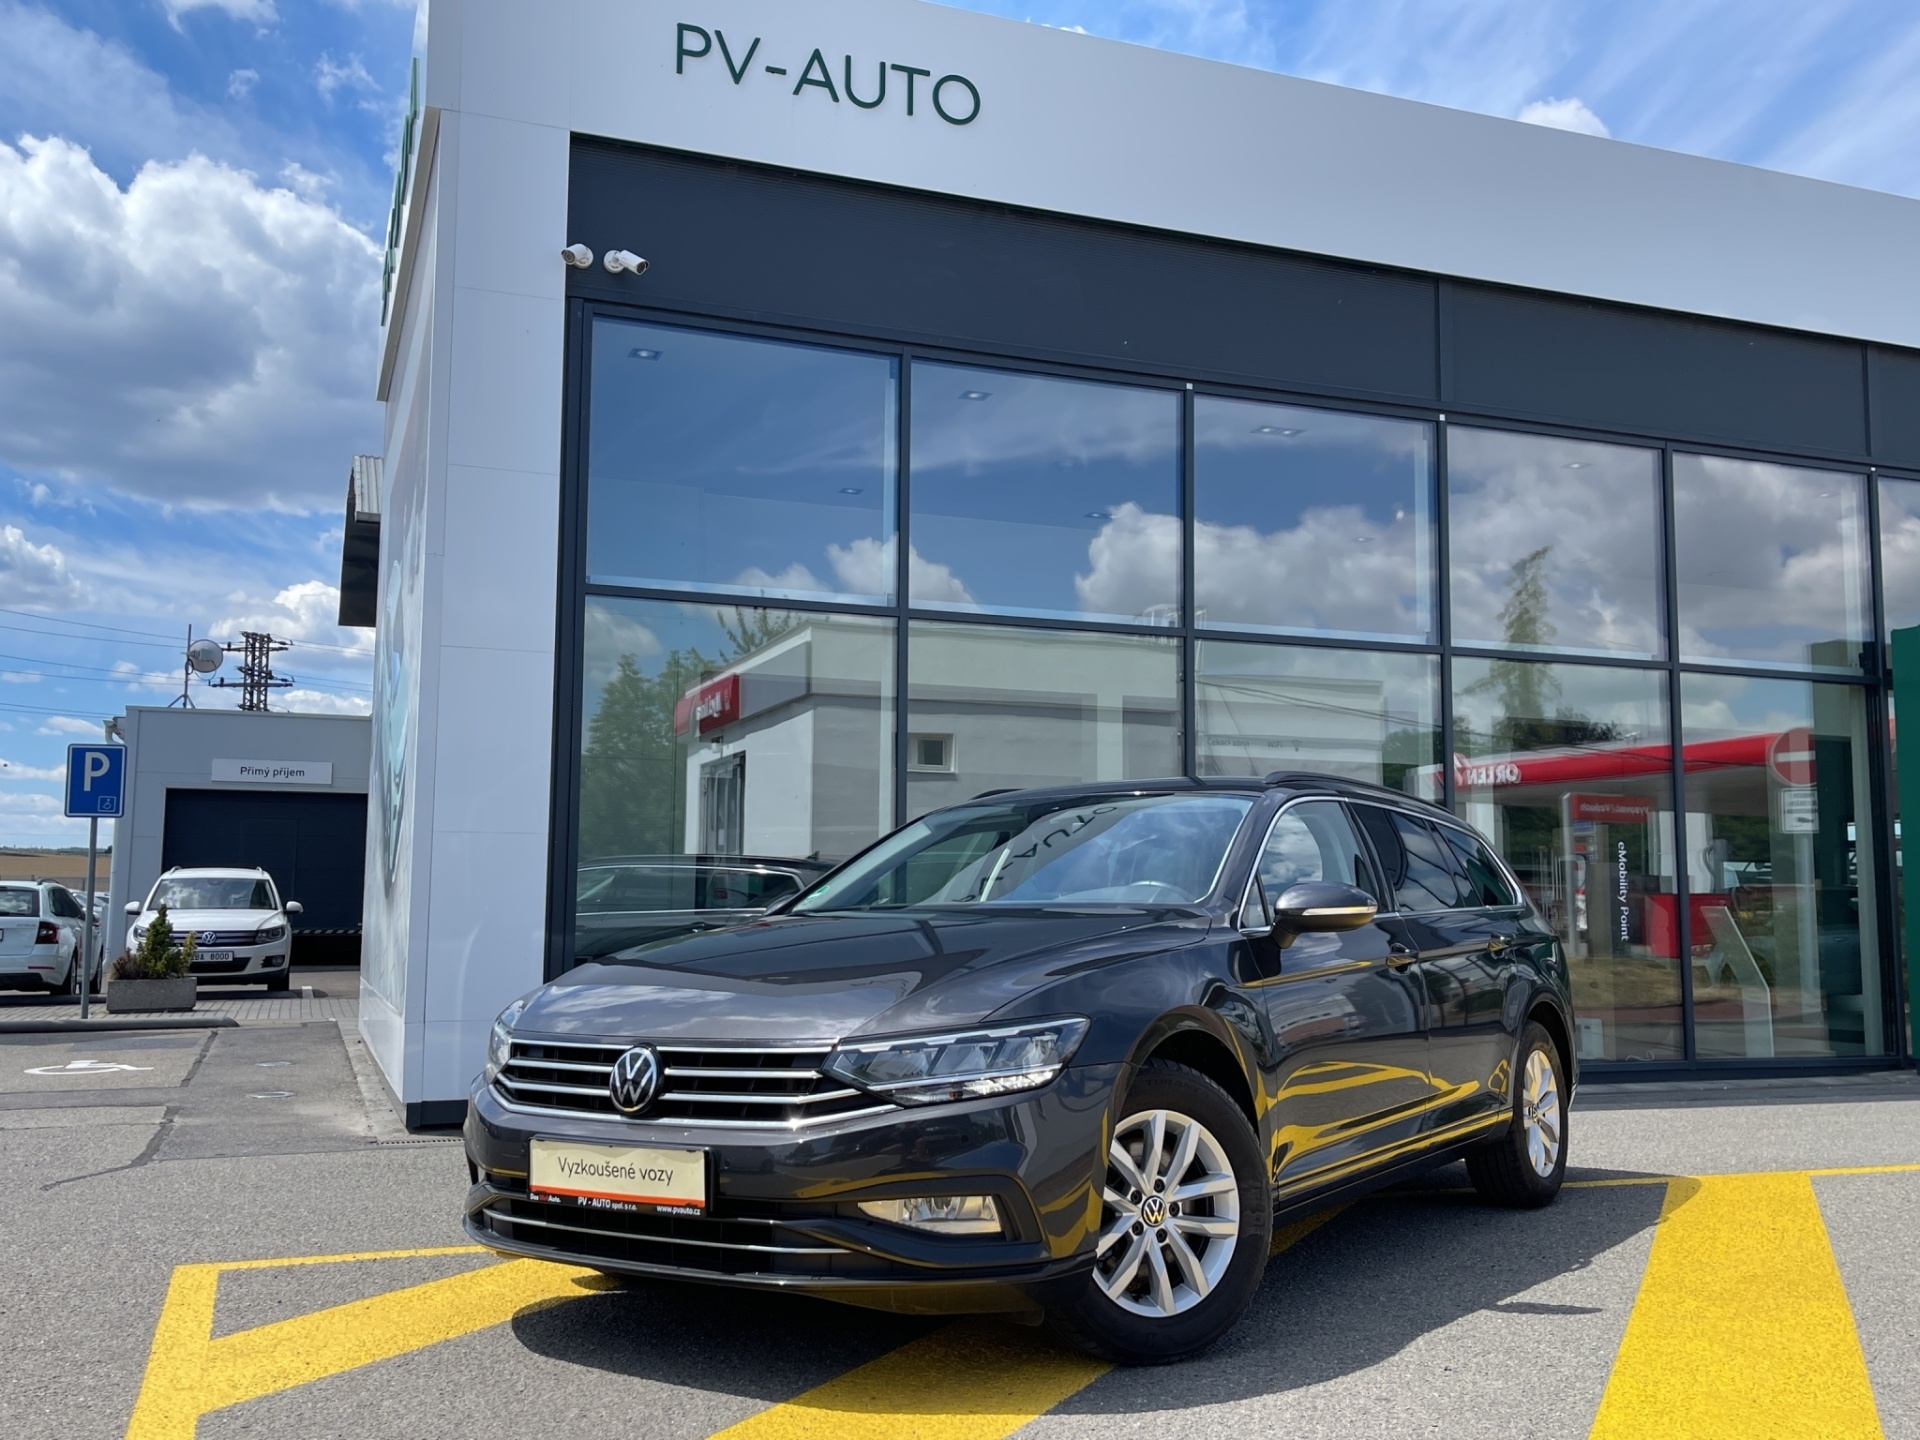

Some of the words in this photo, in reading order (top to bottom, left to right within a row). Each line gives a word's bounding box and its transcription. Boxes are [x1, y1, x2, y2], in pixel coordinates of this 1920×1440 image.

[676, 22, 981, 125] PV-AUTO
[83, 751, 110, 792] P
[240, 766, 270, 778] Přímý
[272, 767, 305, 779] příjem
[1617, 841, 1629, 903] eMobility
[1620, 906, 1630, 941] Point
[210, 952, 230, 961] 8000
[557, 1156, 636, 1179] Vyzkoušené
[638, 1168, 674, 1187] vozy
[577, 1196, 588, 1206] PV
[592, 1199, 611, 1209] AUTO
[611, 1202, 624, 1211] spol.
[656, 1205, 701, 1216] www.pvauto.cz
